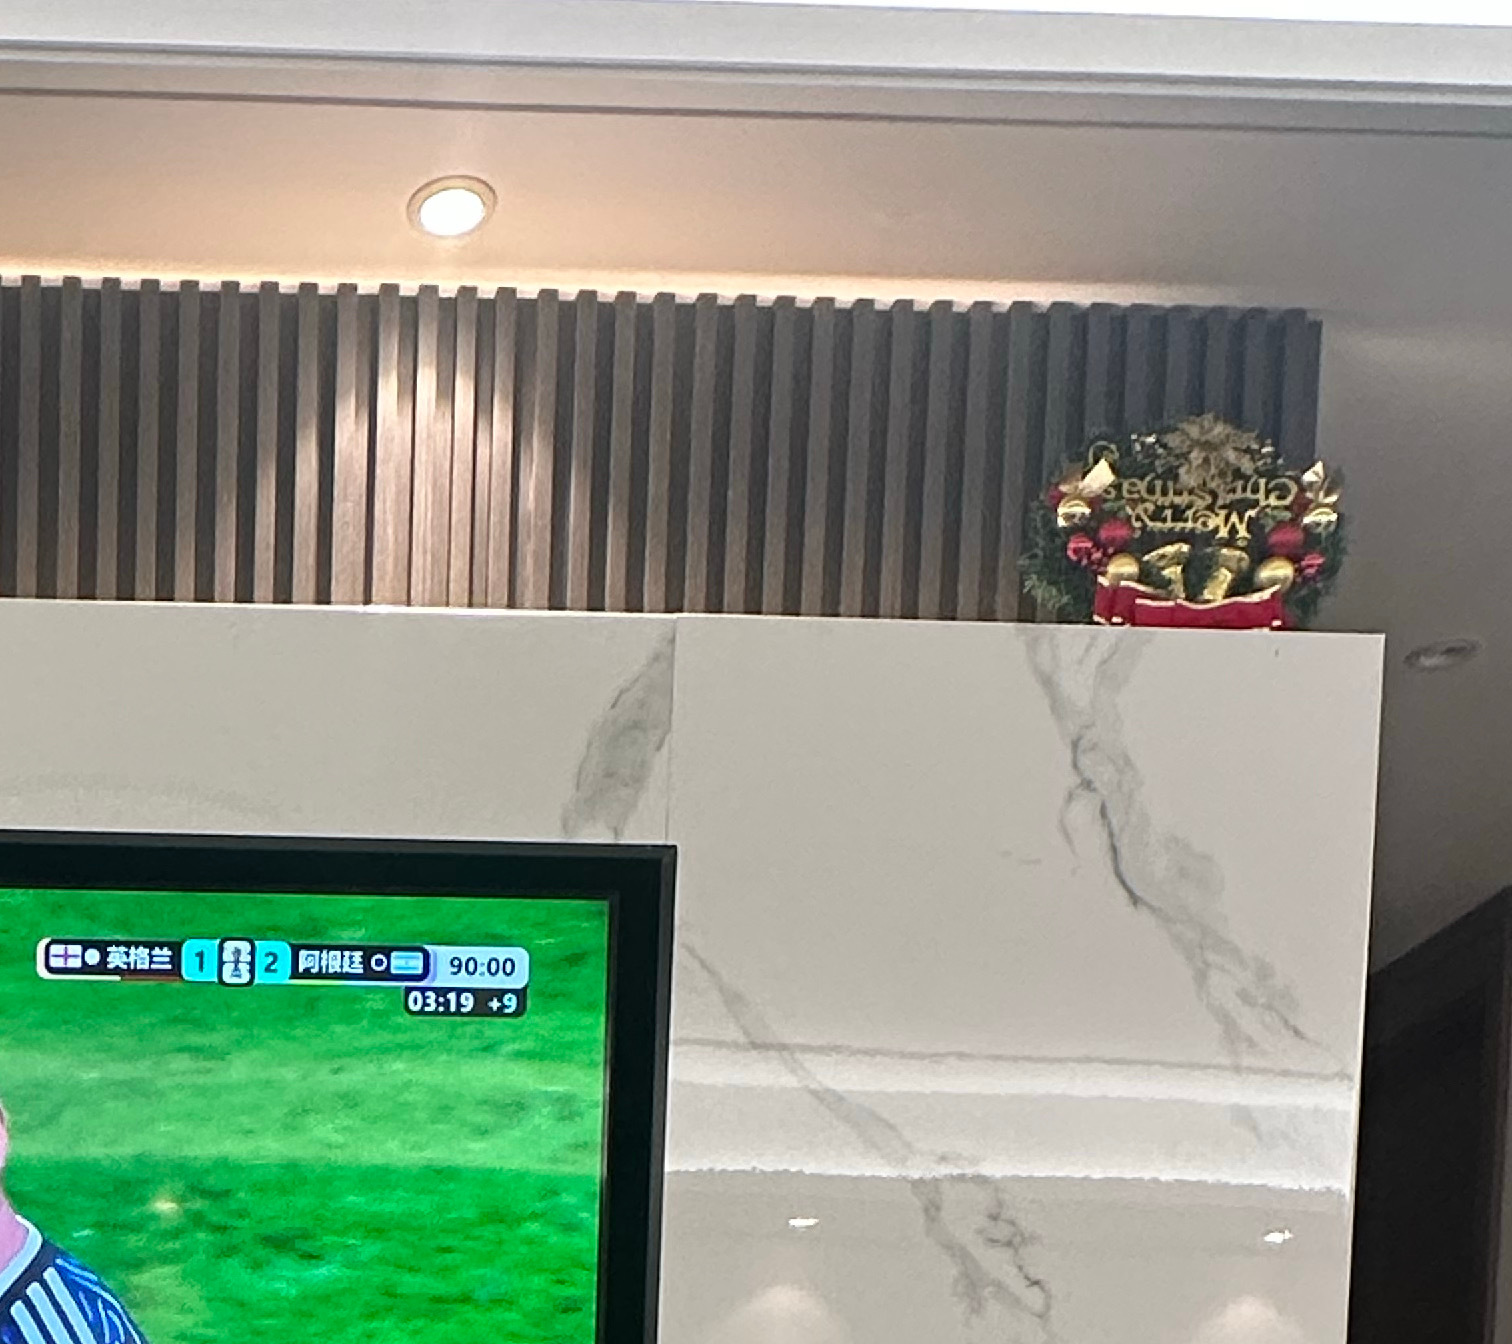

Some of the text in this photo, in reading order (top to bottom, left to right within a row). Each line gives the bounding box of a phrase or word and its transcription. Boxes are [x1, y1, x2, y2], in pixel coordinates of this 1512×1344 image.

[106, 944, 517, 978] 英格兰 1 2 阿根廷 90:00
[407, 990, 519, 1014] 03:19 +9
